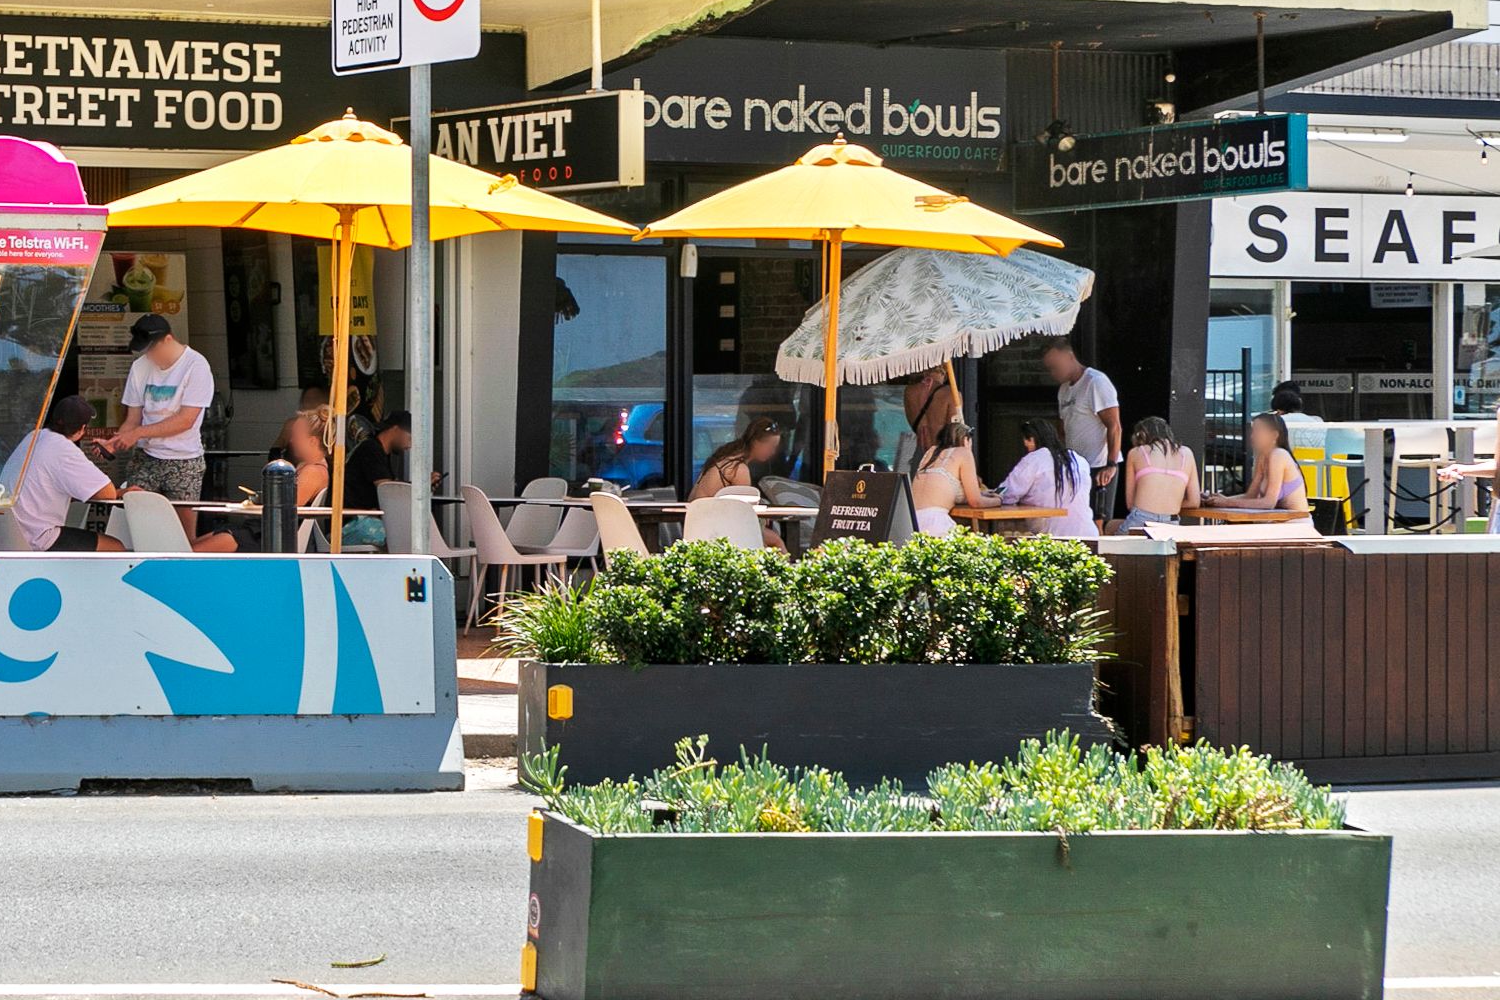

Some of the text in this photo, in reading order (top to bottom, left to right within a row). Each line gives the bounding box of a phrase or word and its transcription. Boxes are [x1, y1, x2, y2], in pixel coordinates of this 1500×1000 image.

[342, 13, 394, 36] PEDESTRIAN
[348, 35, 388, 56] ACTIVITY
[154, 89, 283, 131] FOOD
[633, 78, 1001, 140] bare naked bowls
[487, 109, 572, 163] VIET
[882, 144, 998, 160] SUPERFOOD CAFE
[1050, 130, 1286, 188] bare naked bowls
[520, 166, 573, 182] FOOD
[8, 235, 52, 250] Telstra
[1246, 205, 1500, 264] SEAF
[9, 250, 24, 258] here
[25, 250, 34, 258] for
[83, 303, 121, 313] MOOTHIES
[352, 295, 369, 309] DAYS
[1307, 379, 1334, 388] MEALS
[831, 505, 878, 517] REFRESHING
[832, 519, 871, 532] FRUIT TEA
